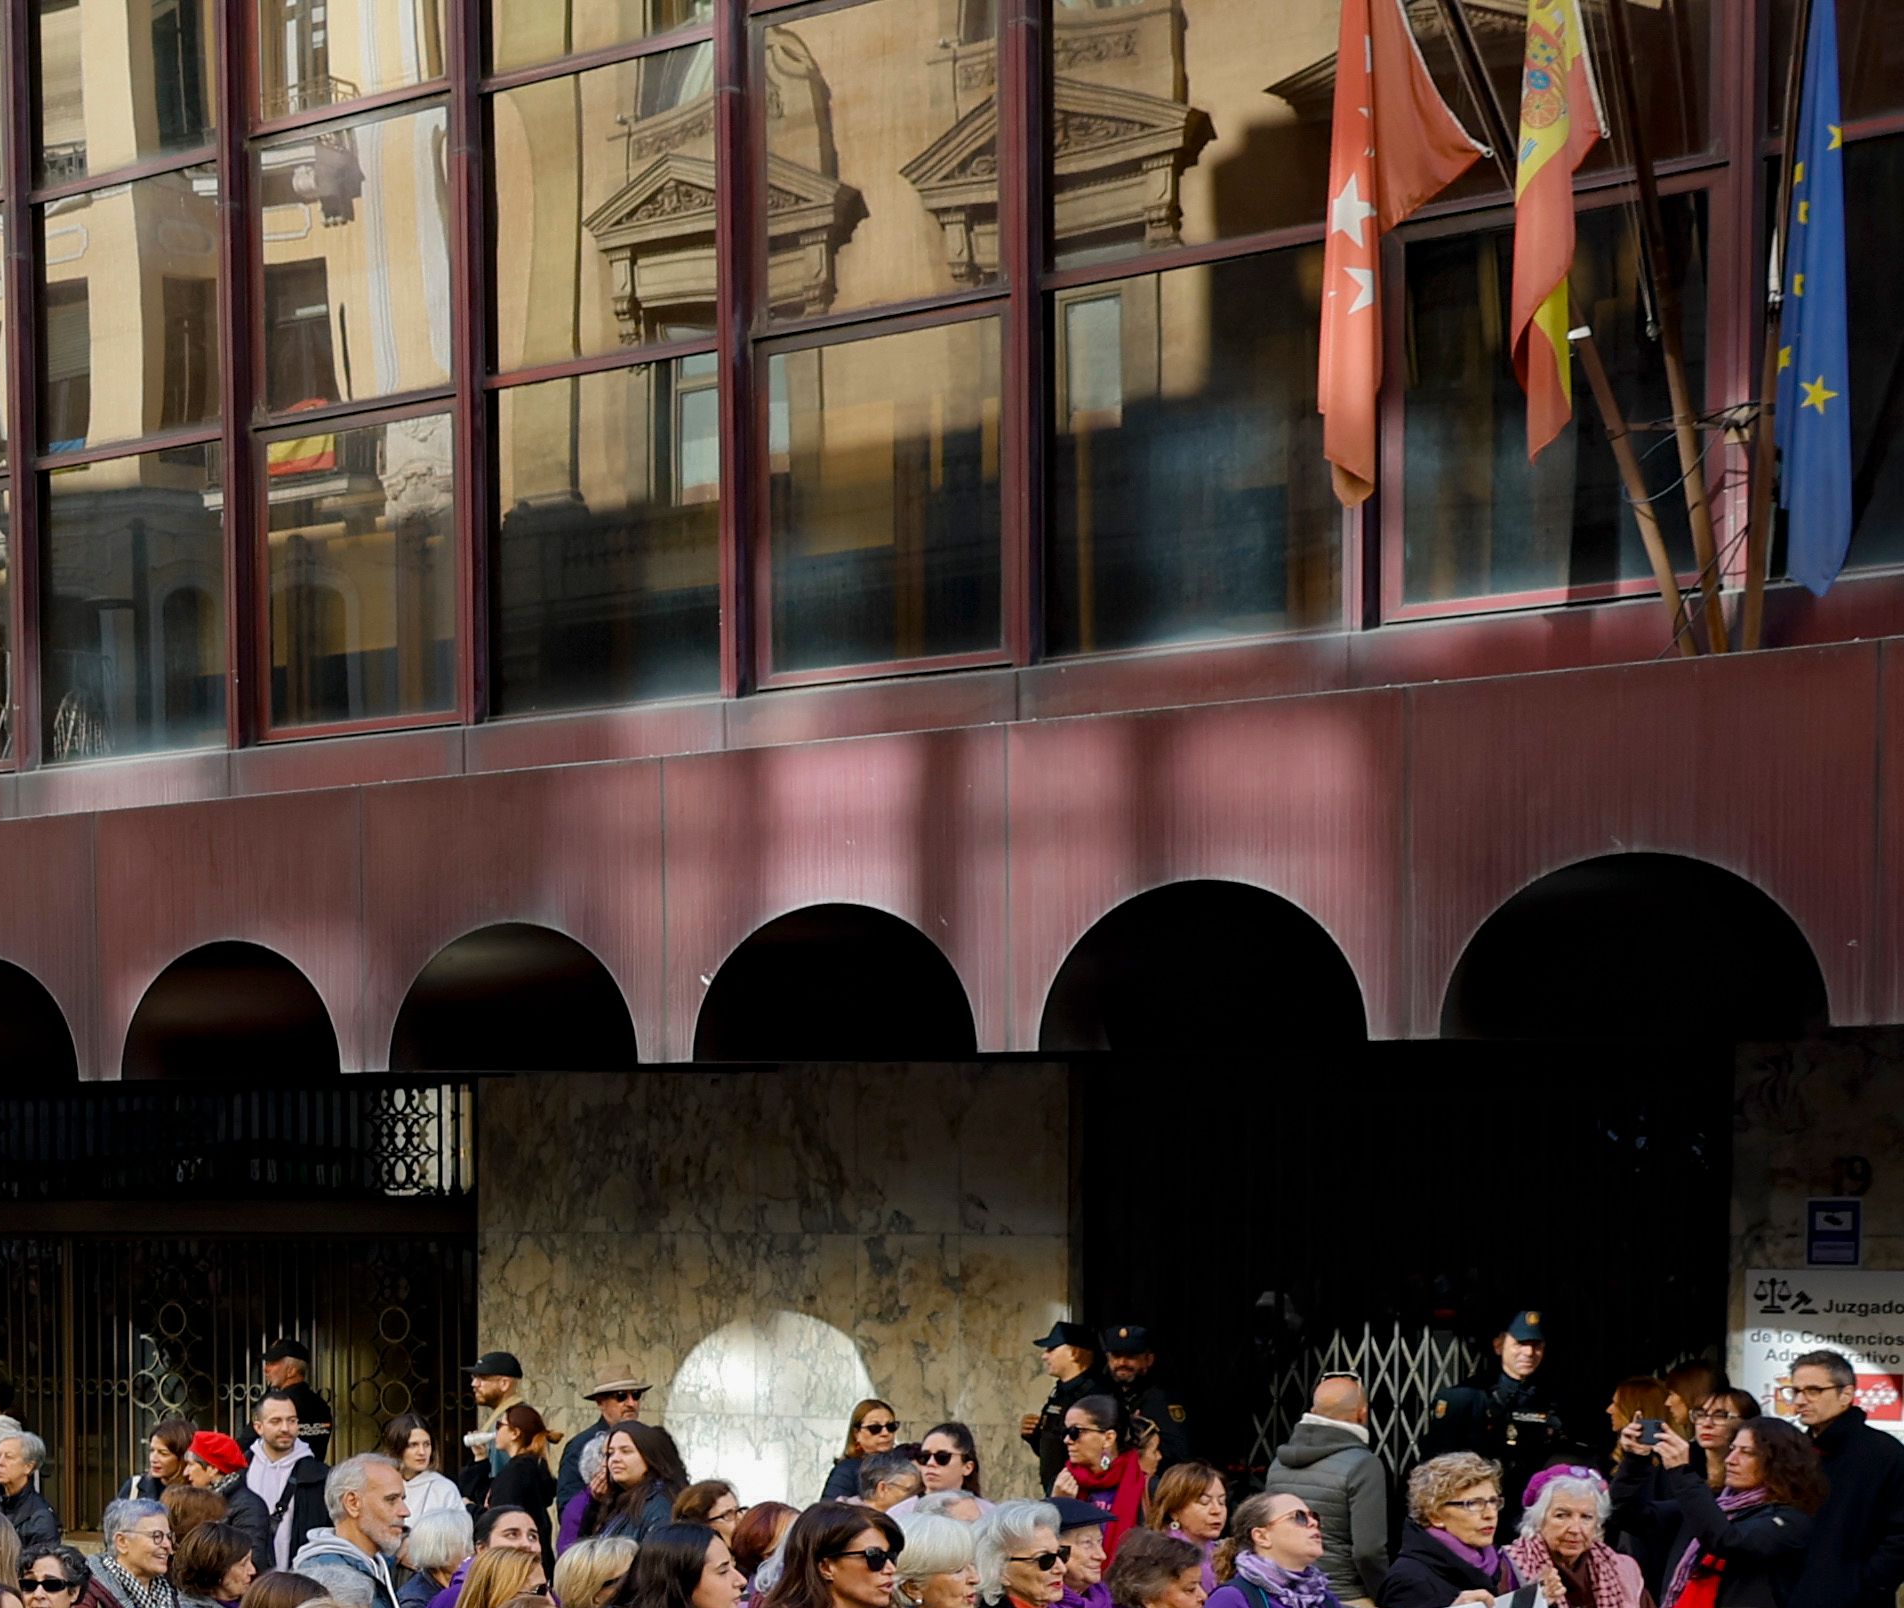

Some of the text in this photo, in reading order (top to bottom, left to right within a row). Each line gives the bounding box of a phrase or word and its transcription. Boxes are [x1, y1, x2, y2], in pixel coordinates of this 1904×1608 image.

[1833, 1155, 1872, 1197] 19
[1823, 1300, 1904, 1317] Juzgado
[1750, 1330, 1904, 1346] de lo Contencios
